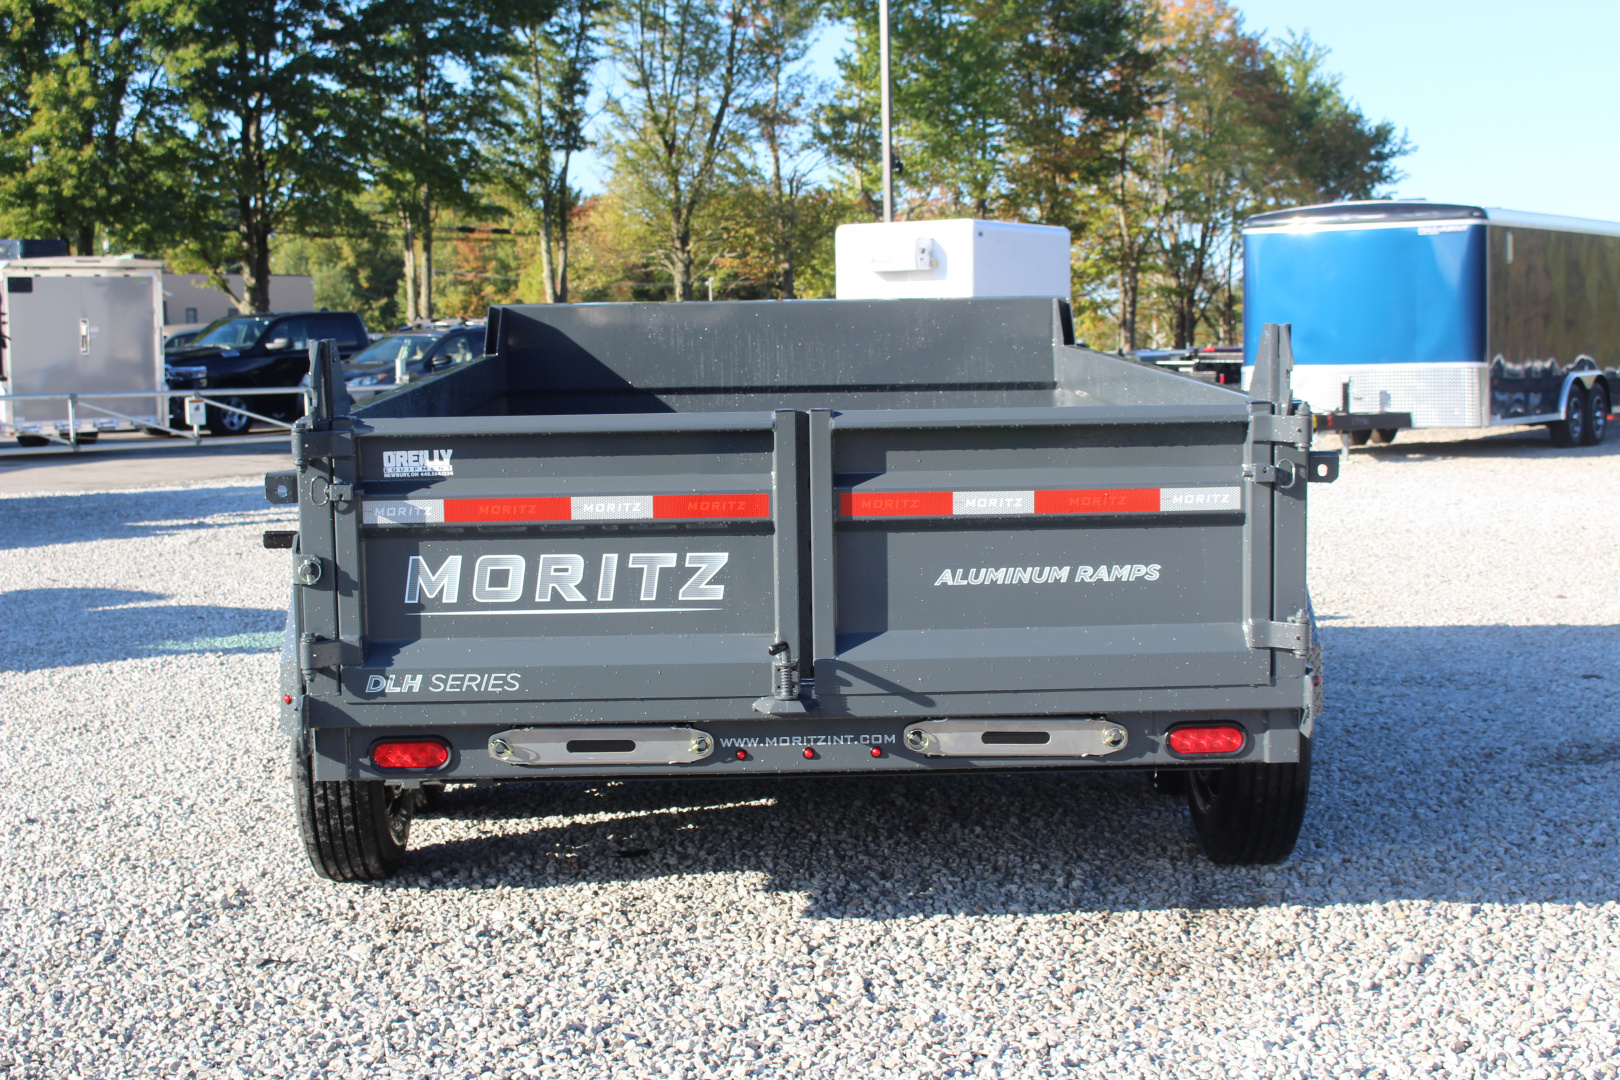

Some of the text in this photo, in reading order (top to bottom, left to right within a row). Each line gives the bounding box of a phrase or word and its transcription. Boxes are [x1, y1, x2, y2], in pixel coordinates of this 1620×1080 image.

[861, 499, 919, 509] MORITZ
[965, 497, 1024, 508] MORITZ
[1068, 496, 1127, 506] MORITZ
[1172, 493, 1231, 504] MORITZ
[374, 506, 432, 517] MORITZ
[478, 505, 537, 515] MORITZ
[583, 502, 642, 513] MORITZ
[687, 501, 746, 512] MORITZ
[405, 552, 729, 603] MORITZ
[934, 564, 1162, 586] ALUMINUM RAMPS
[365, 673, 522, 693] DLH SERIES
[720, 734, 896, 748] WWW.MORITZINT.COM
